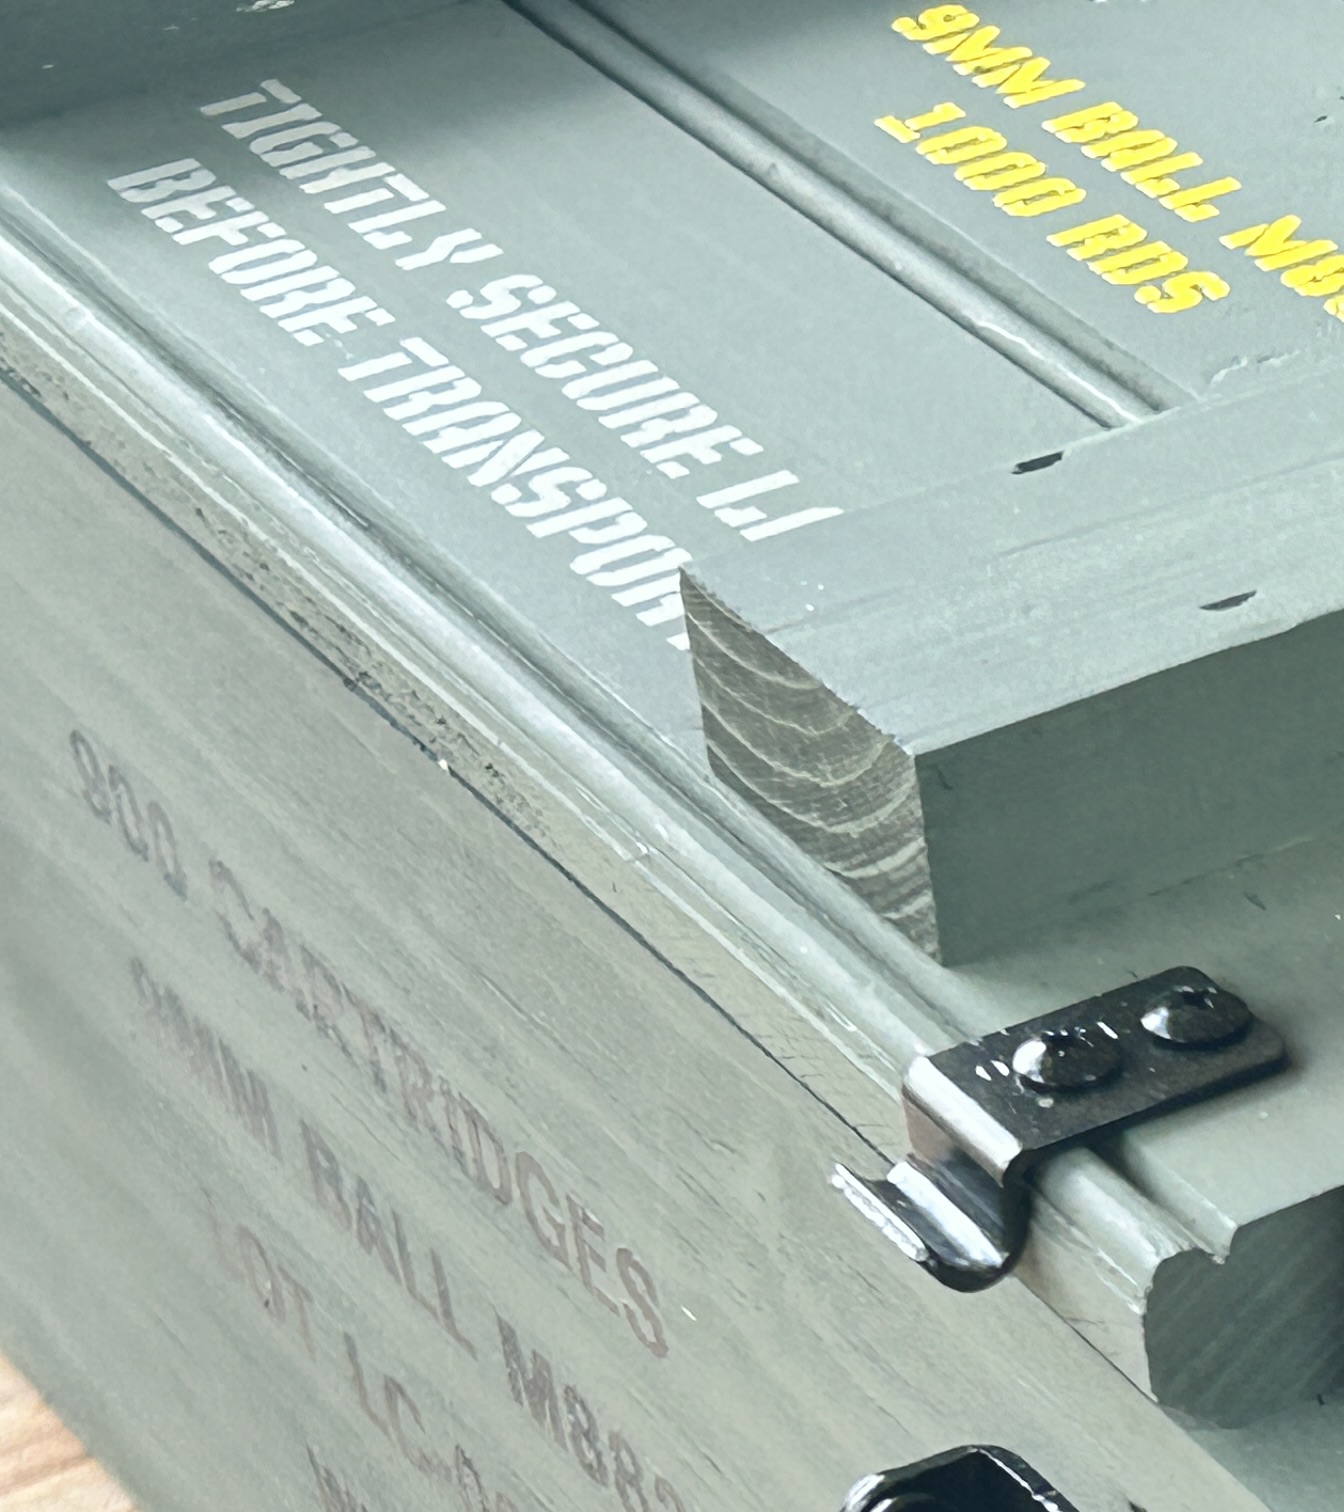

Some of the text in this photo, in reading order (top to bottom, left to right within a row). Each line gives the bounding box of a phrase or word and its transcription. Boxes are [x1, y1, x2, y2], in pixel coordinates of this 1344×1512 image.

[874, 102, 1230, 314] 1000 RDS
[892, 4, 1086, 109] 9MM
[1041, 101, 1241, 222] BALL
[106, 157, 693, 652] BEFORE TRANSPOR
[200, 79, 503, 270] TIGHTLY
[445, 273, 764, 480] SECURE
[208, 858, 669, 1359] CARTRIDGES
[301, 1116, 479, 1362] BALL
